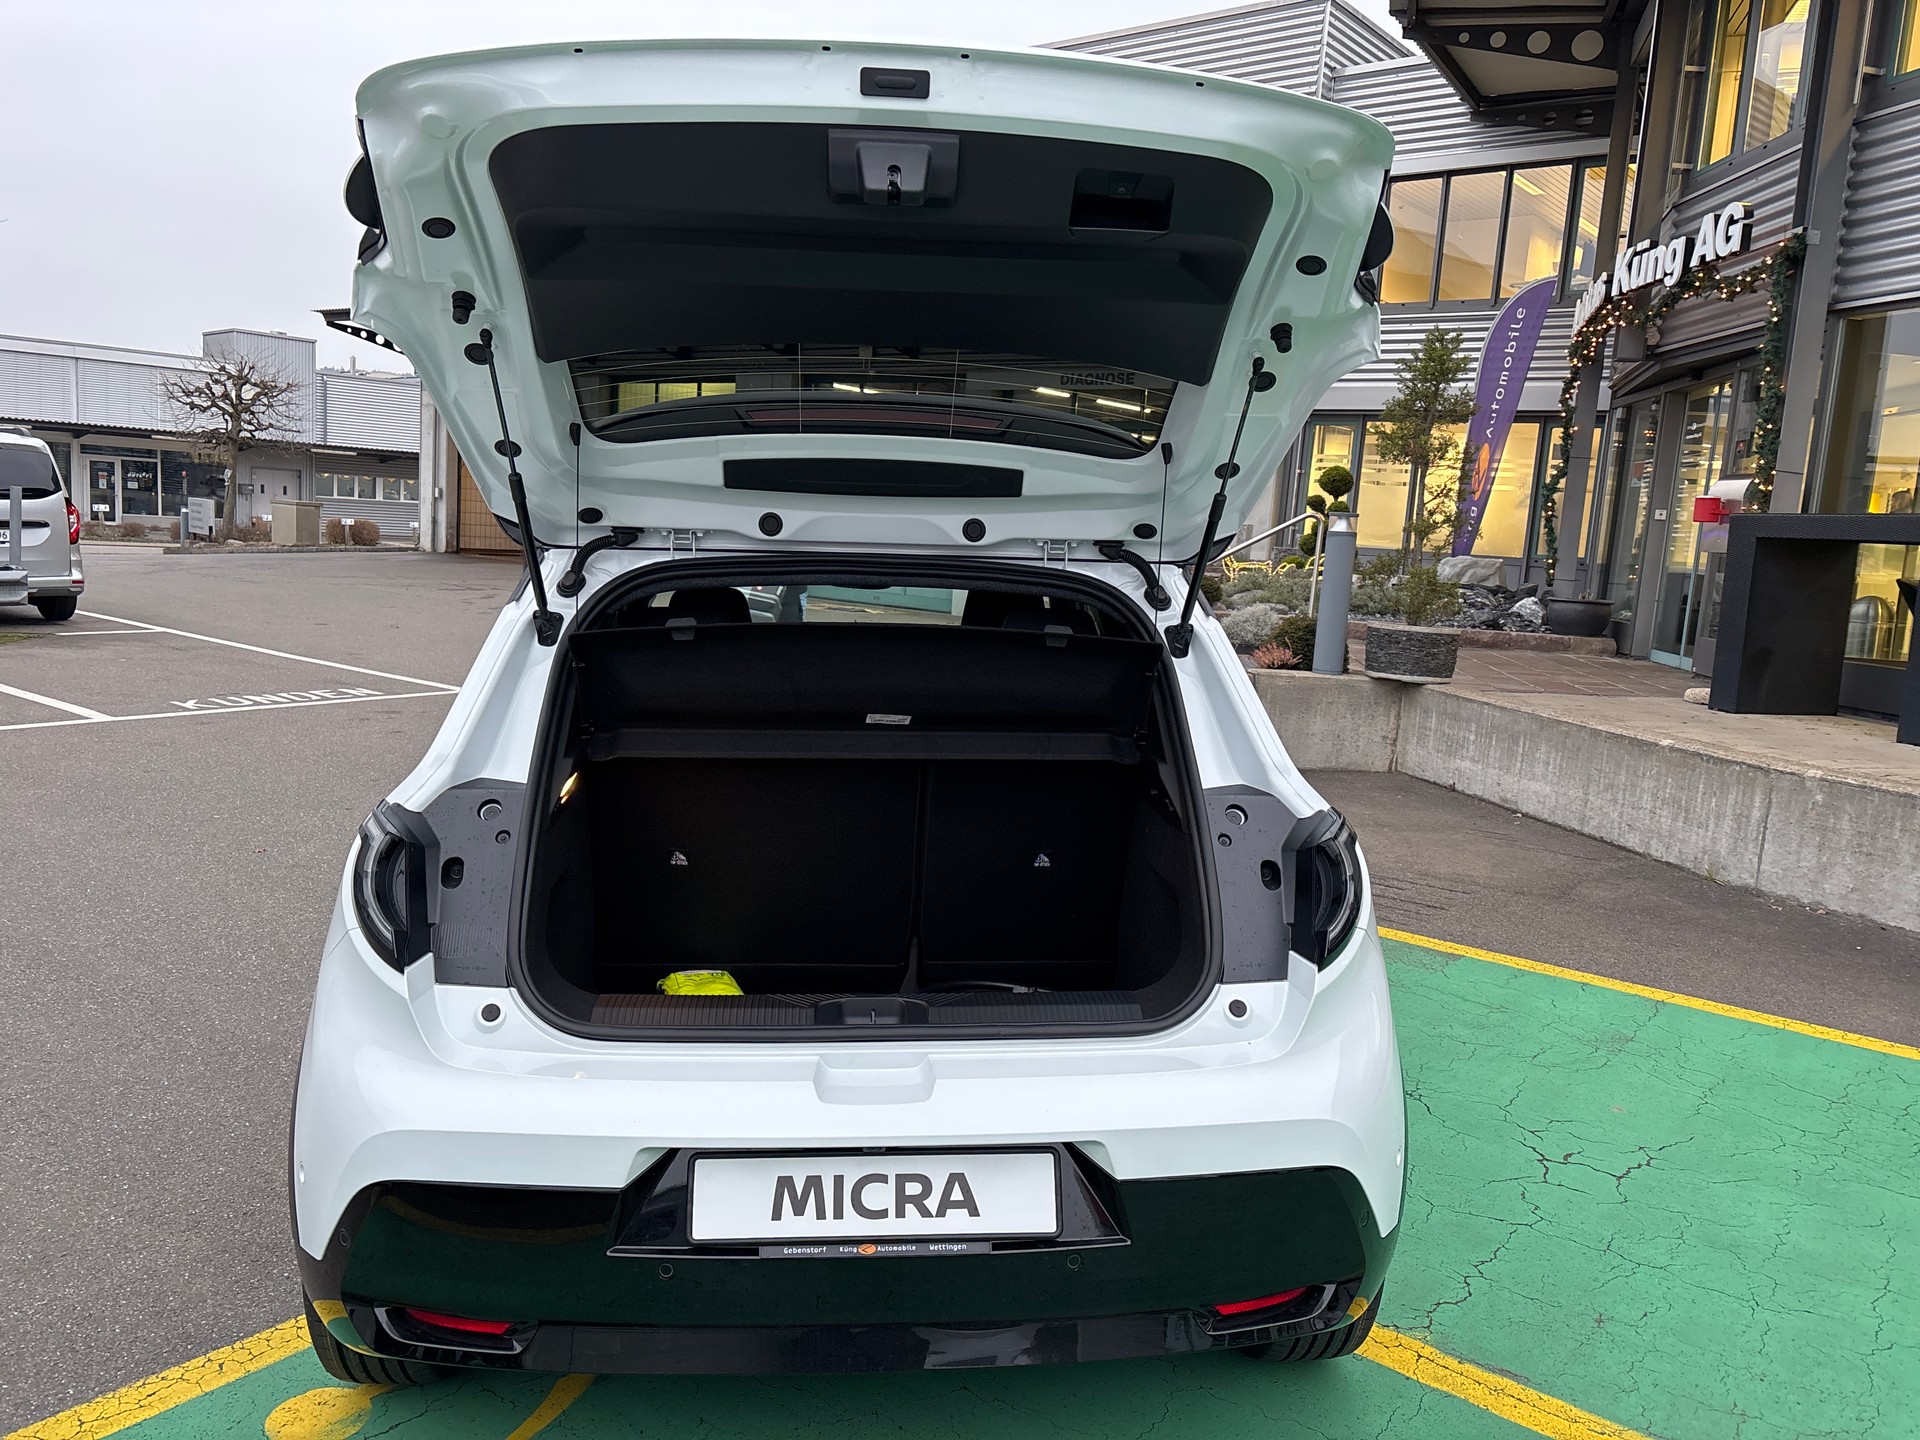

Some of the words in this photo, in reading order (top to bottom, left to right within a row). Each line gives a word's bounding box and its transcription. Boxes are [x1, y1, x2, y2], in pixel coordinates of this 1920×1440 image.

[1611, 236, 1687, 297] Küng
[1689, 201, 1745, 267] AG
[1060, 372, 1136, 386] DIAGNOSE
[1485, 306, 1527, 439] Automobile
[169, 687, 385, 710] KUNDEN
[771, 1172, 981, 1221] MICRA
[783, 1246, 827, 1255] Gebenstorf
[839, 1245, 858, 1254] Küng
[877, 1244, 917, 1252] Automobile
[929, 1243, 967, 1253] Wettingen
